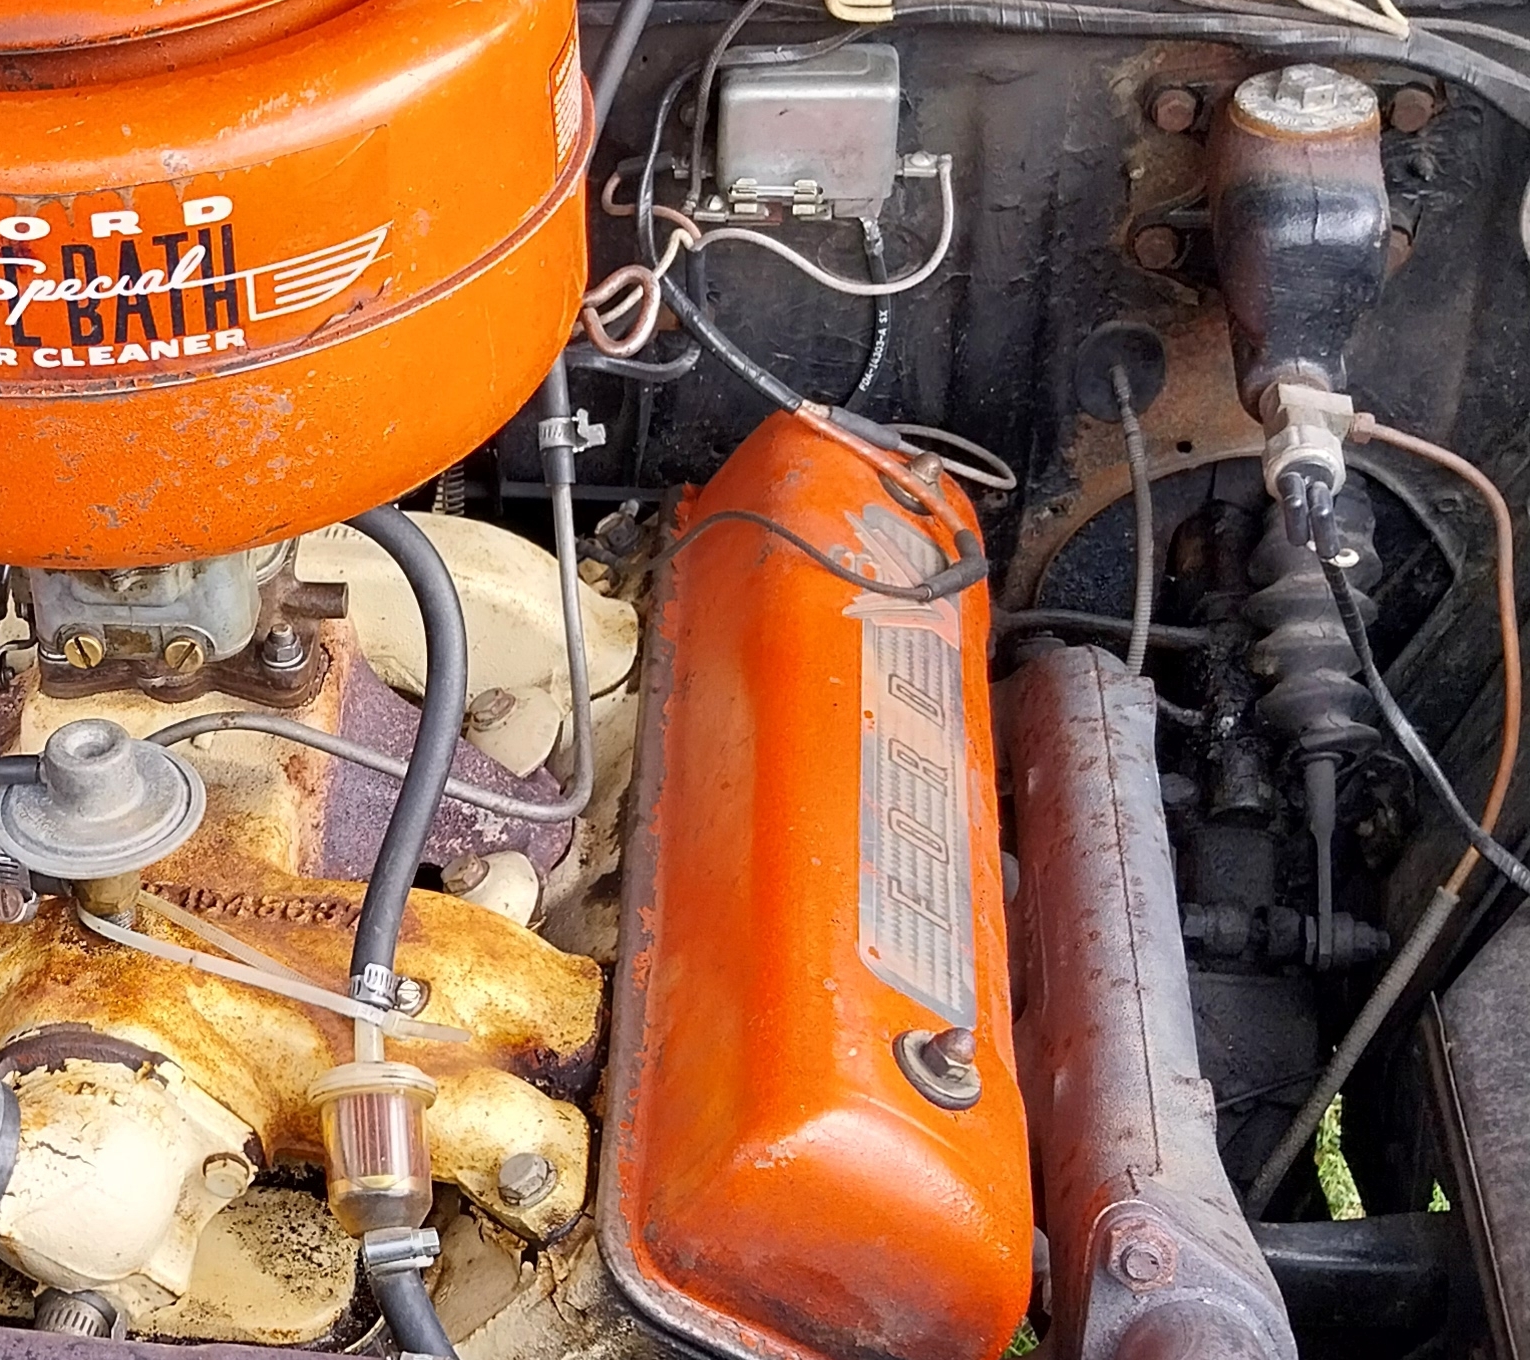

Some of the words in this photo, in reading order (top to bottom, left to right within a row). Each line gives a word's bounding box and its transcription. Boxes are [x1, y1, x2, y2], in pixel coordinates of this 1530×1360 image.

[70, 223, 241, 346] BATH
[33, 328, 246, 368] CLEANER
[888, 673, 952, 935] FORD
